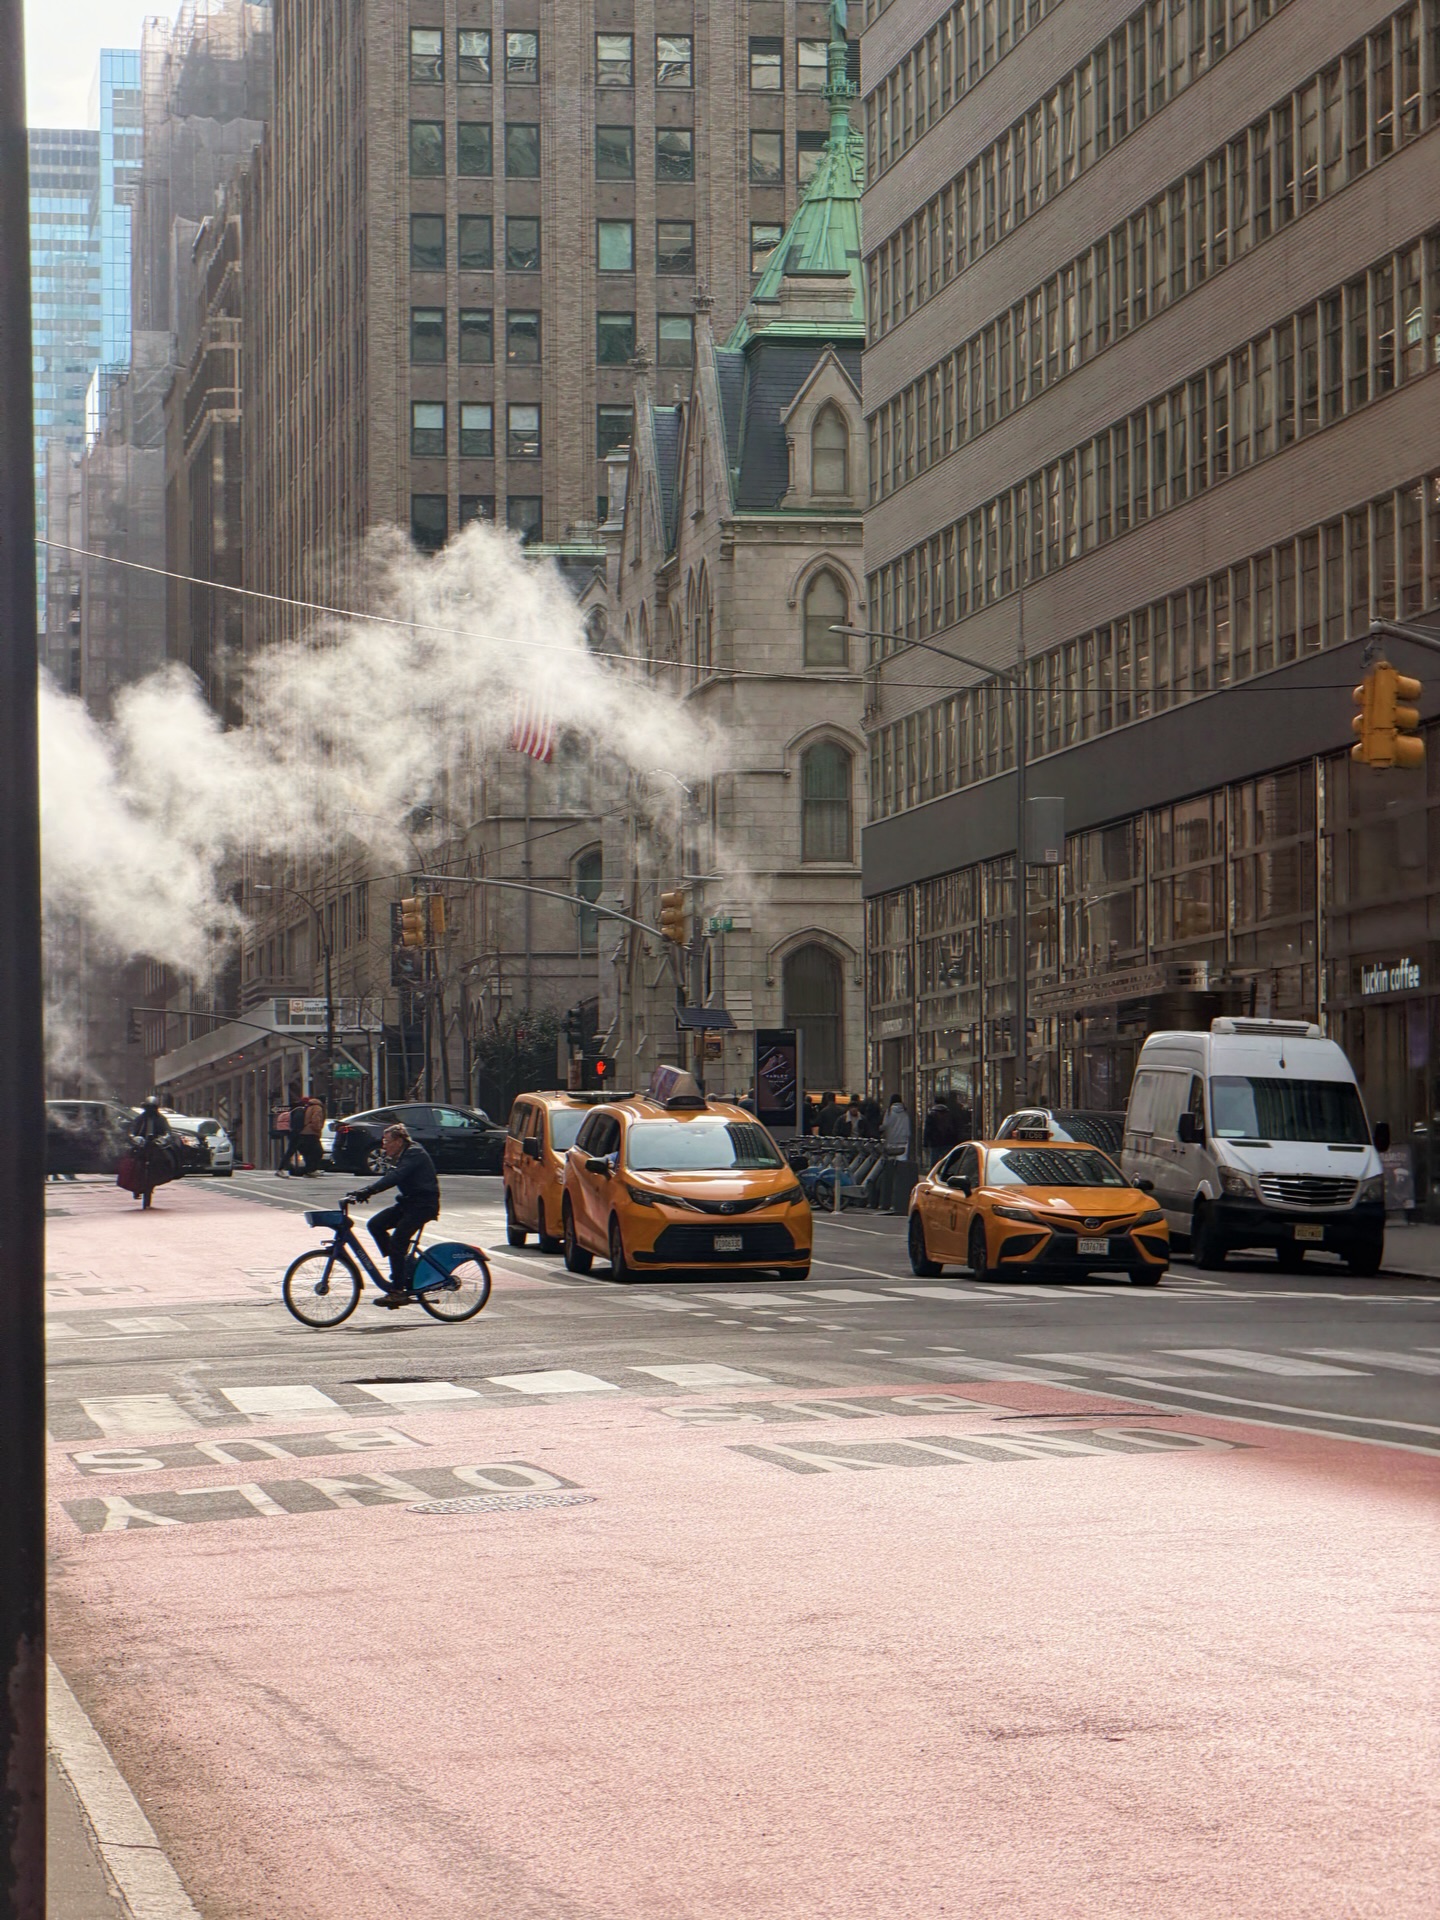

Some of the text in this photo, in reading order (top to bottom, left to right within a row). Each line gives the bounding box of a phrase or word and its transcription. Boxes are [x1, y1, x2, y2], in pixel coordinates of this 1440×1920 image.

[1361, 957, 1419, 995] luckin coffee
[661, 1394, 1020, 1426] BUS
[73, 1426, 426, 1474] BUS
[752, 1427, 1235, 1472] ONLY
[102, 1462, 563, 1532] ONLY
